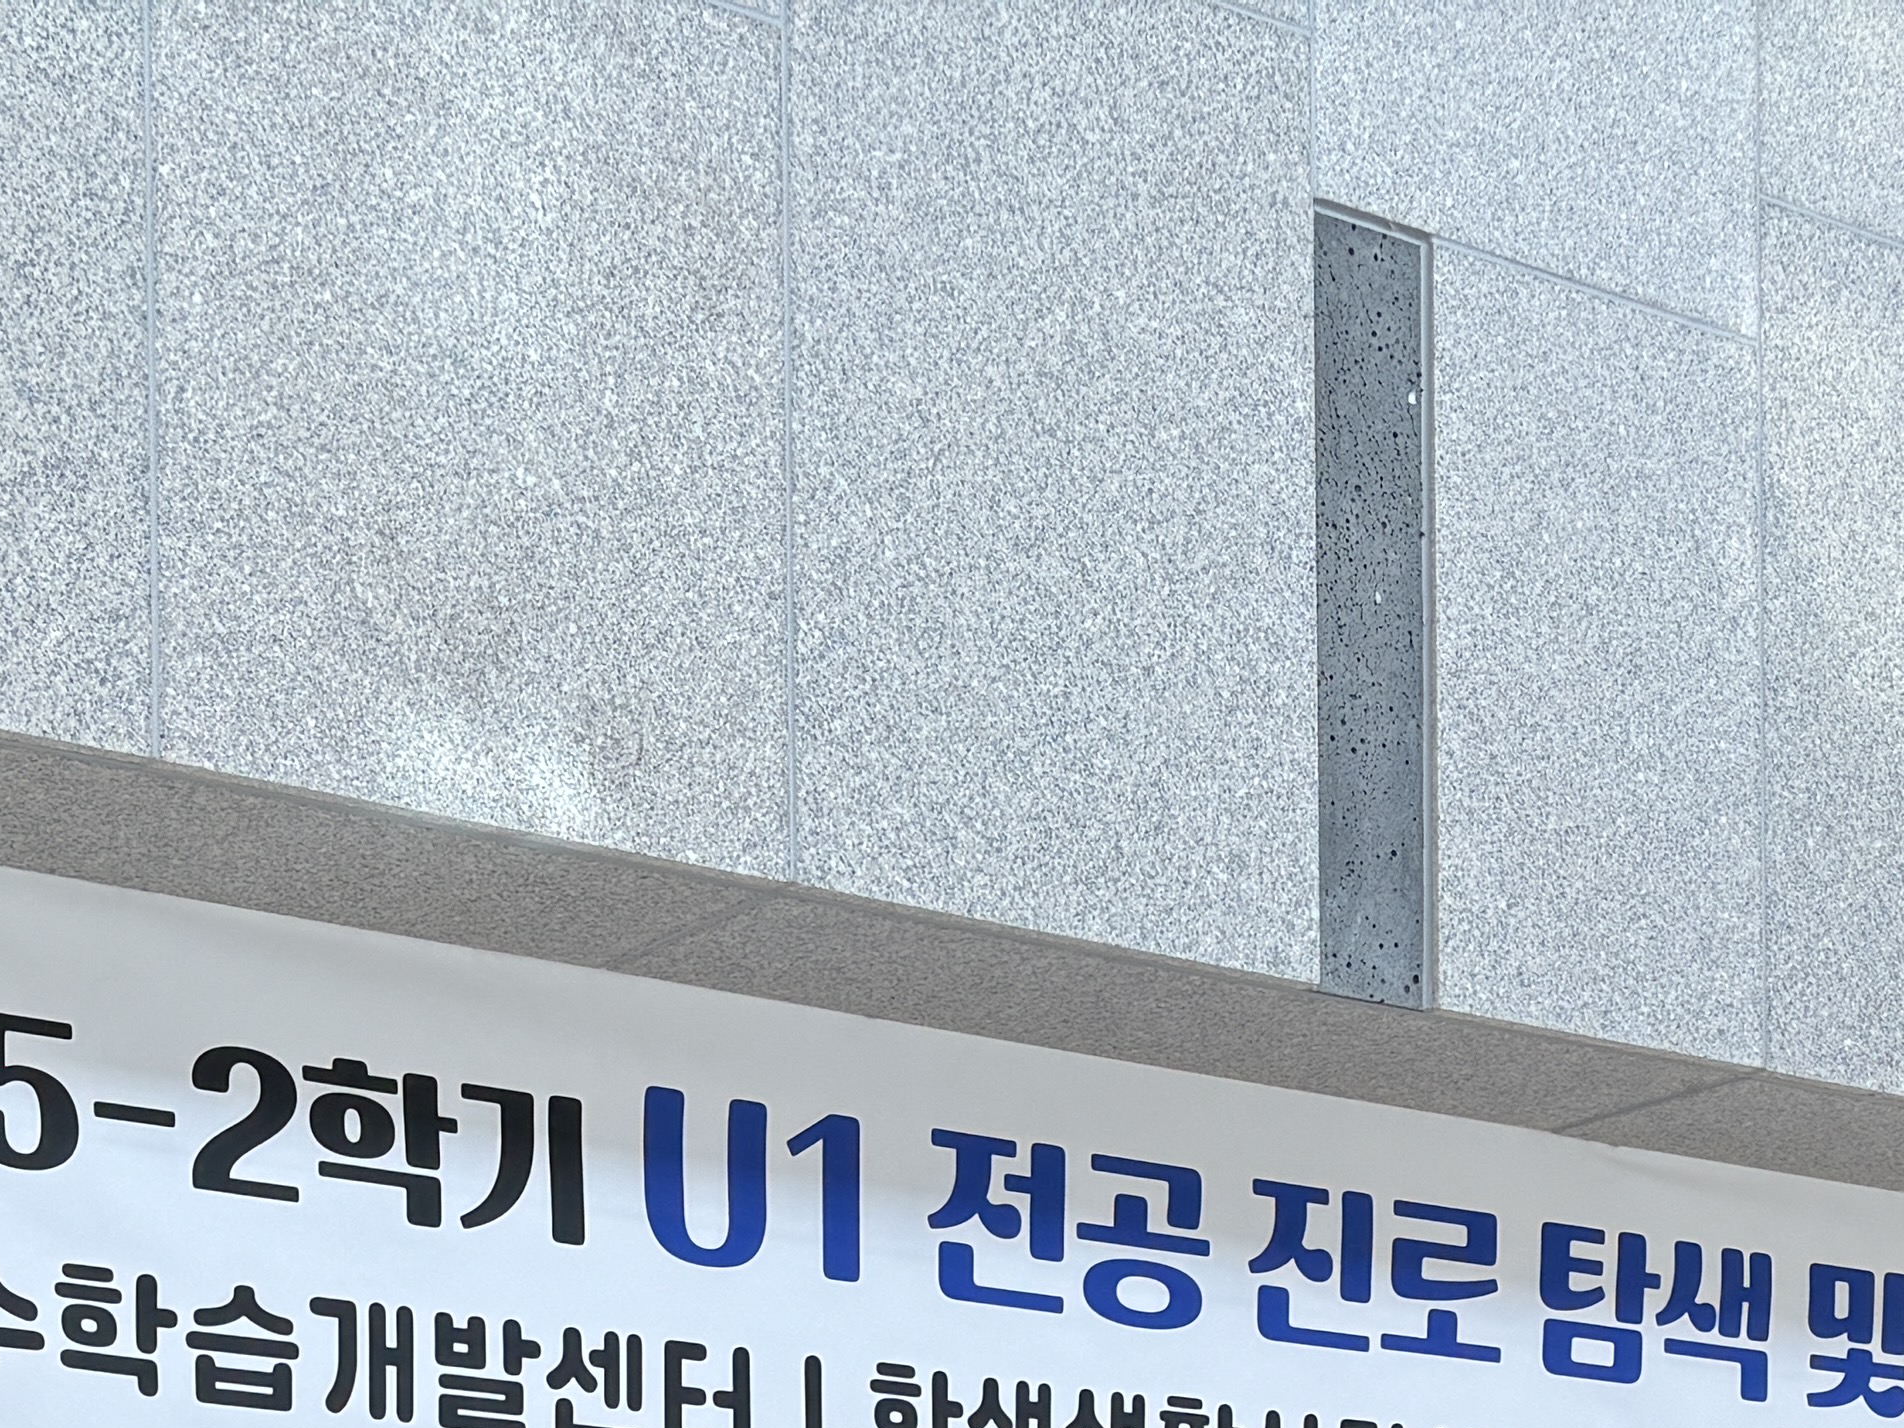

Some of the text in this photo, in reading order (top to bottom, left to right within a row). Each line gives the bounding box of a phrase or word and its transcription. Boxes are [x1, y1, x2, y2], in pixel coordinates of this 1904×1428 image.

[642, 1084, 862, 1284] U1
[926, 1126, 1212, 1331] 전공
[1246, 1177, 1502, 1364] 진로
[1538, 1220, 1774, 1404] 탐색
